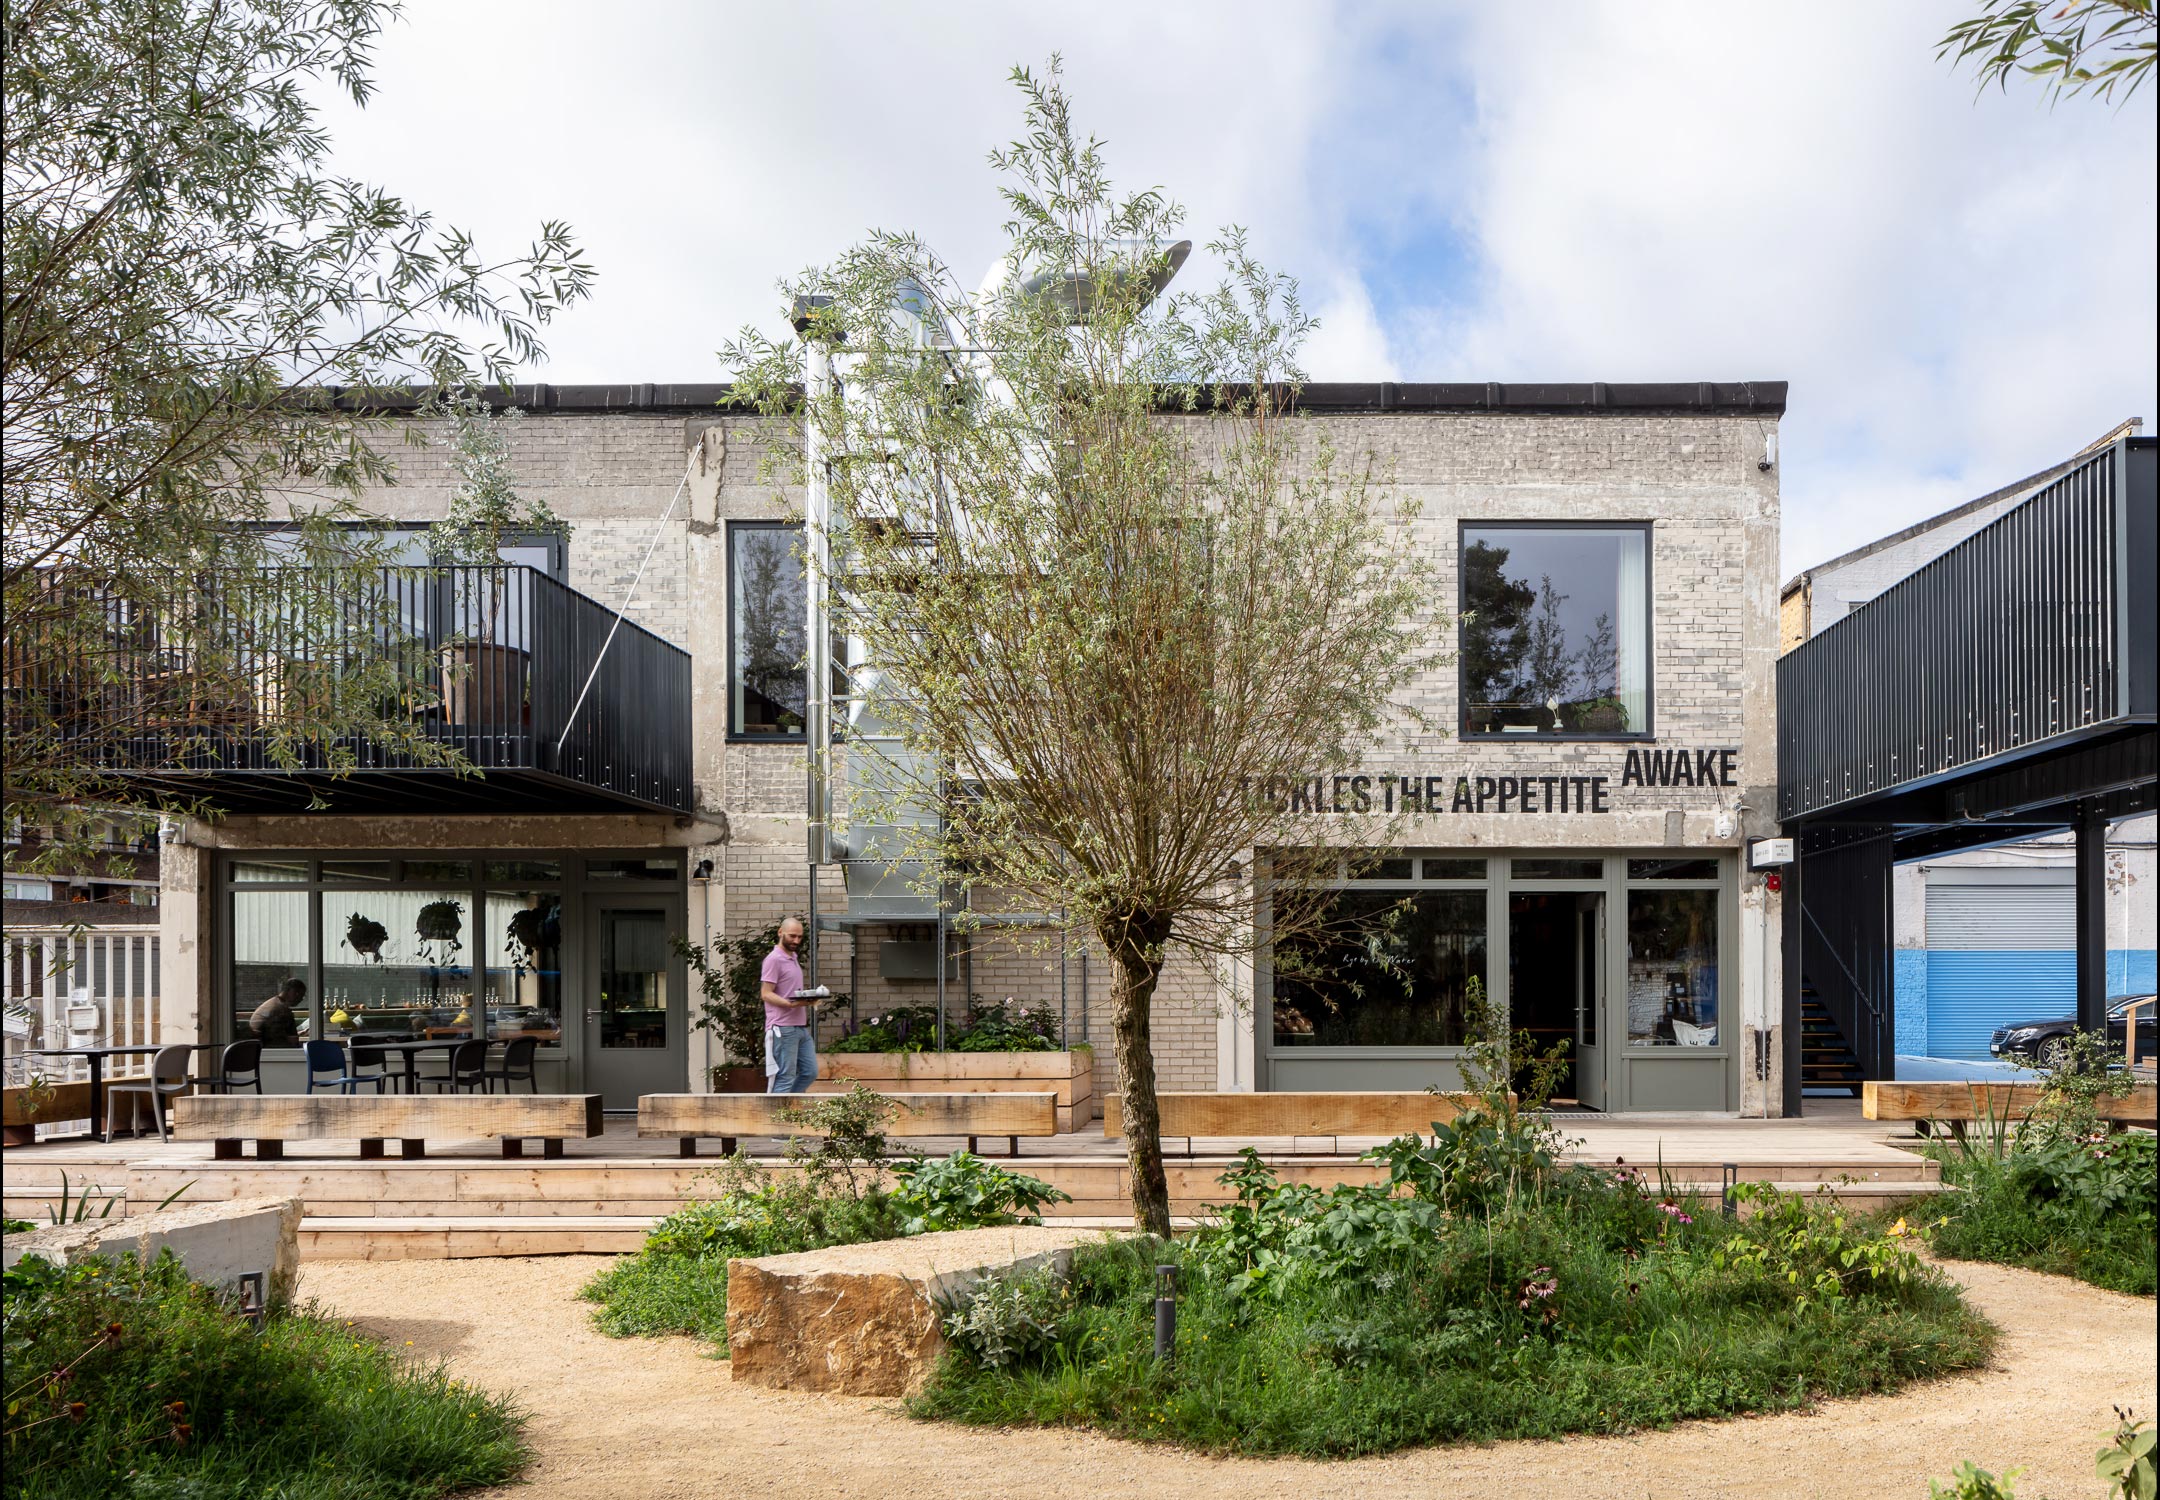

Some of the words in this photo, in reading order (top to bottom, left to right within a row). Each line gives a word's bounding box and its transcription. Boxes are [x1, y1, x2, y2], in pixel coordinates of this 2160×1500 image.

[1621, 749, 1738, 787] AWAKE
[1378, 776, 1443, 814] THE
[1450, 776, 1610, 814] APPETITE
[1342, 954, 1358, 964] Rye
[1359, 955, 1369, 966] by
[1387, 954, 1416, 964] Water
